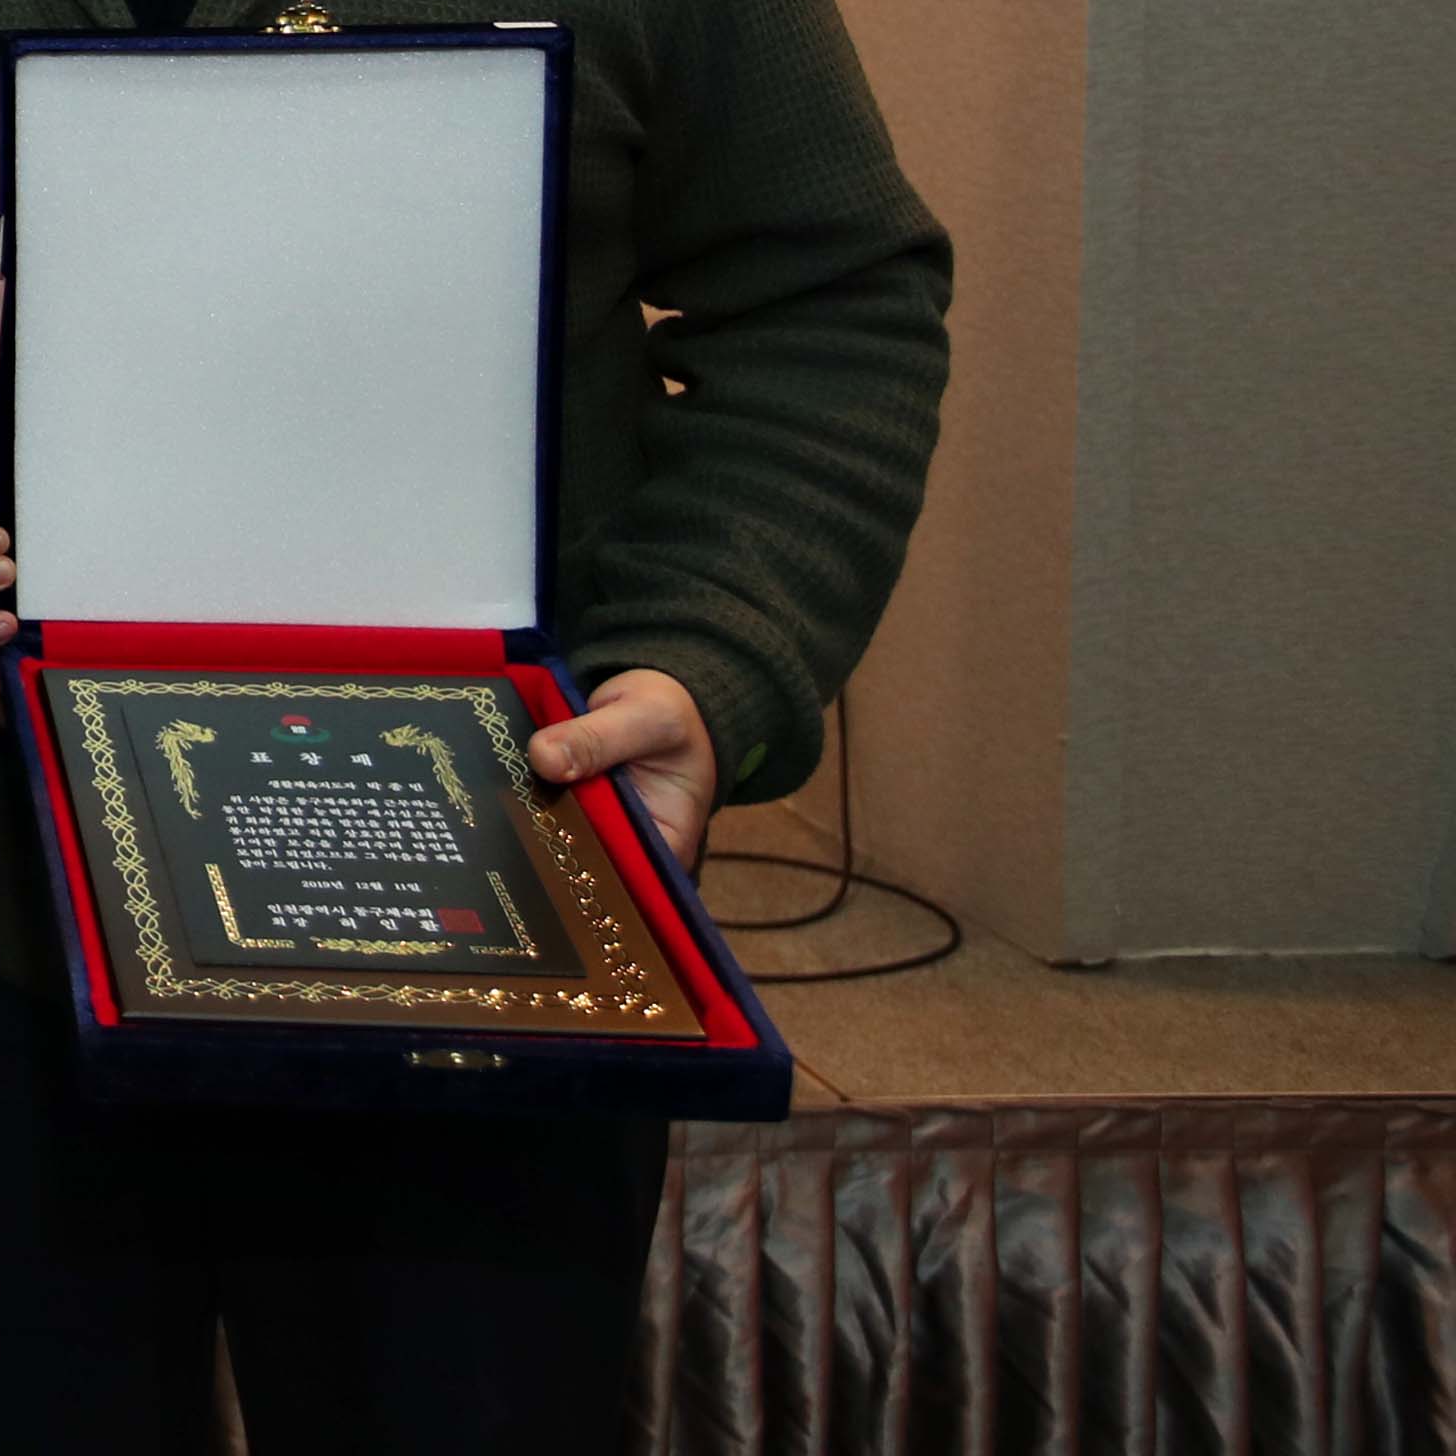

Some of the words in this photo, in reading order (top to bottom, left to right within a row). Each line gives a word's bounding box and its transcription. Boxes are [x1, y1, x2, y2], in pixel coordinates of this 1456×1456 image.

[302, 881, 344, 889] 2019년
[268, 904, 346, 915] 인천광역시
[352, 907, 434, 918] 동구체육회
